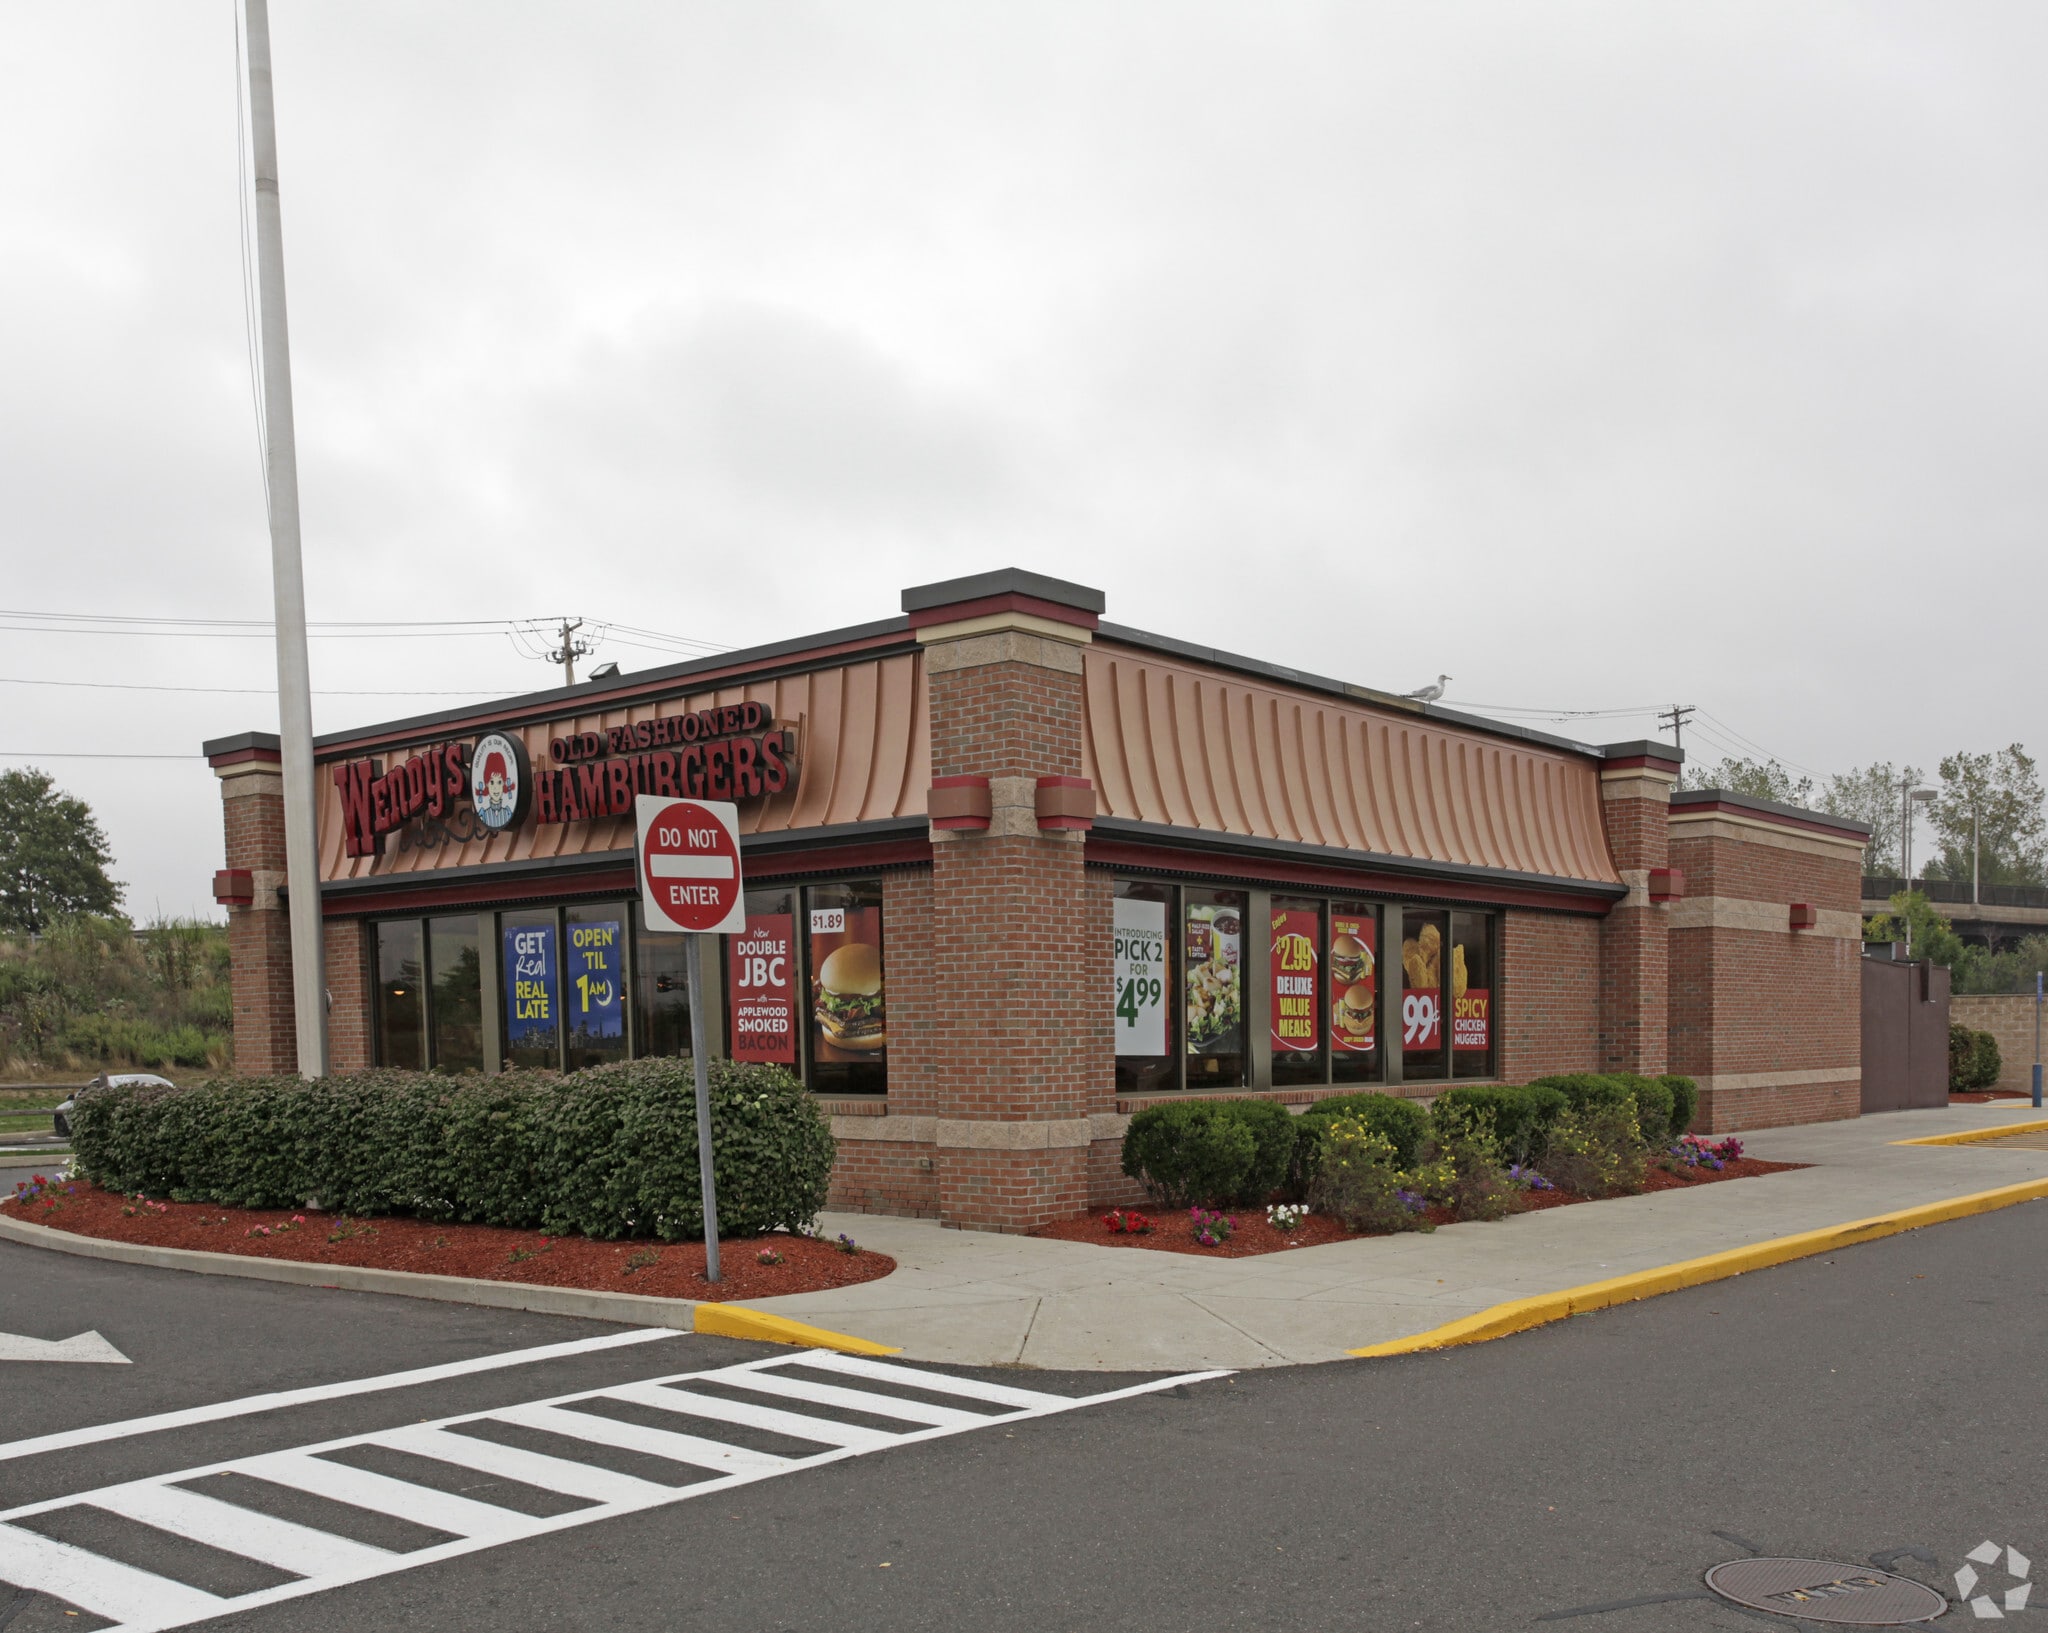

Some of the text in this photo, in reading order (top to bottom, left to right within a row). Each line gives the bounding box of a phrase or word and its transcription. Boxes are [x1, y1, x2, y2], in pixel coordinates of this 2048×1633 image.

[550, 701, 763, 764] OLD FASHIONED
[534, 731, 789, 824] HAMBURGERS
[659, 827, 718, 849] DO NOT
[669, 885, 720, 905] ENTER
[812, 914, 843, 930] $1.89
[515, 931, 546, 954] GET
[573, 927, 613, 948] OPEN
[1114, 927, 1163, 941] INTRODUCING
[737, 940, 786, 955] DOUBLE
[1114, 938, 1163, 962] PICK 2
[1276, 935, 1312, 971] $2.99
[516, 949, 546, 981] Real
[738, 957, 786, 987] JBC
[1129, 963, 1148, 975] FOR
[516, 980, 548, 999] REAL
[1277, 976, 1313, 995] DELUXE
[516, 999, 549, 1019] LATE
[737, 1006, 788, 1017] APPLEWOOD
[1279, 998, 1311, 1016] VALUE
[1455, 998, 1488, 1018] SPICY
[737, 1018, 788, 1033] SMOKED
[1278, 1018, 1311, 1037] MEALS
[1454, 1019, 1486, 1032] CHICKEN
[738, 1033, 788, 1051] BACON
[1454, 1033, 1486, 1045] NUGGETS
